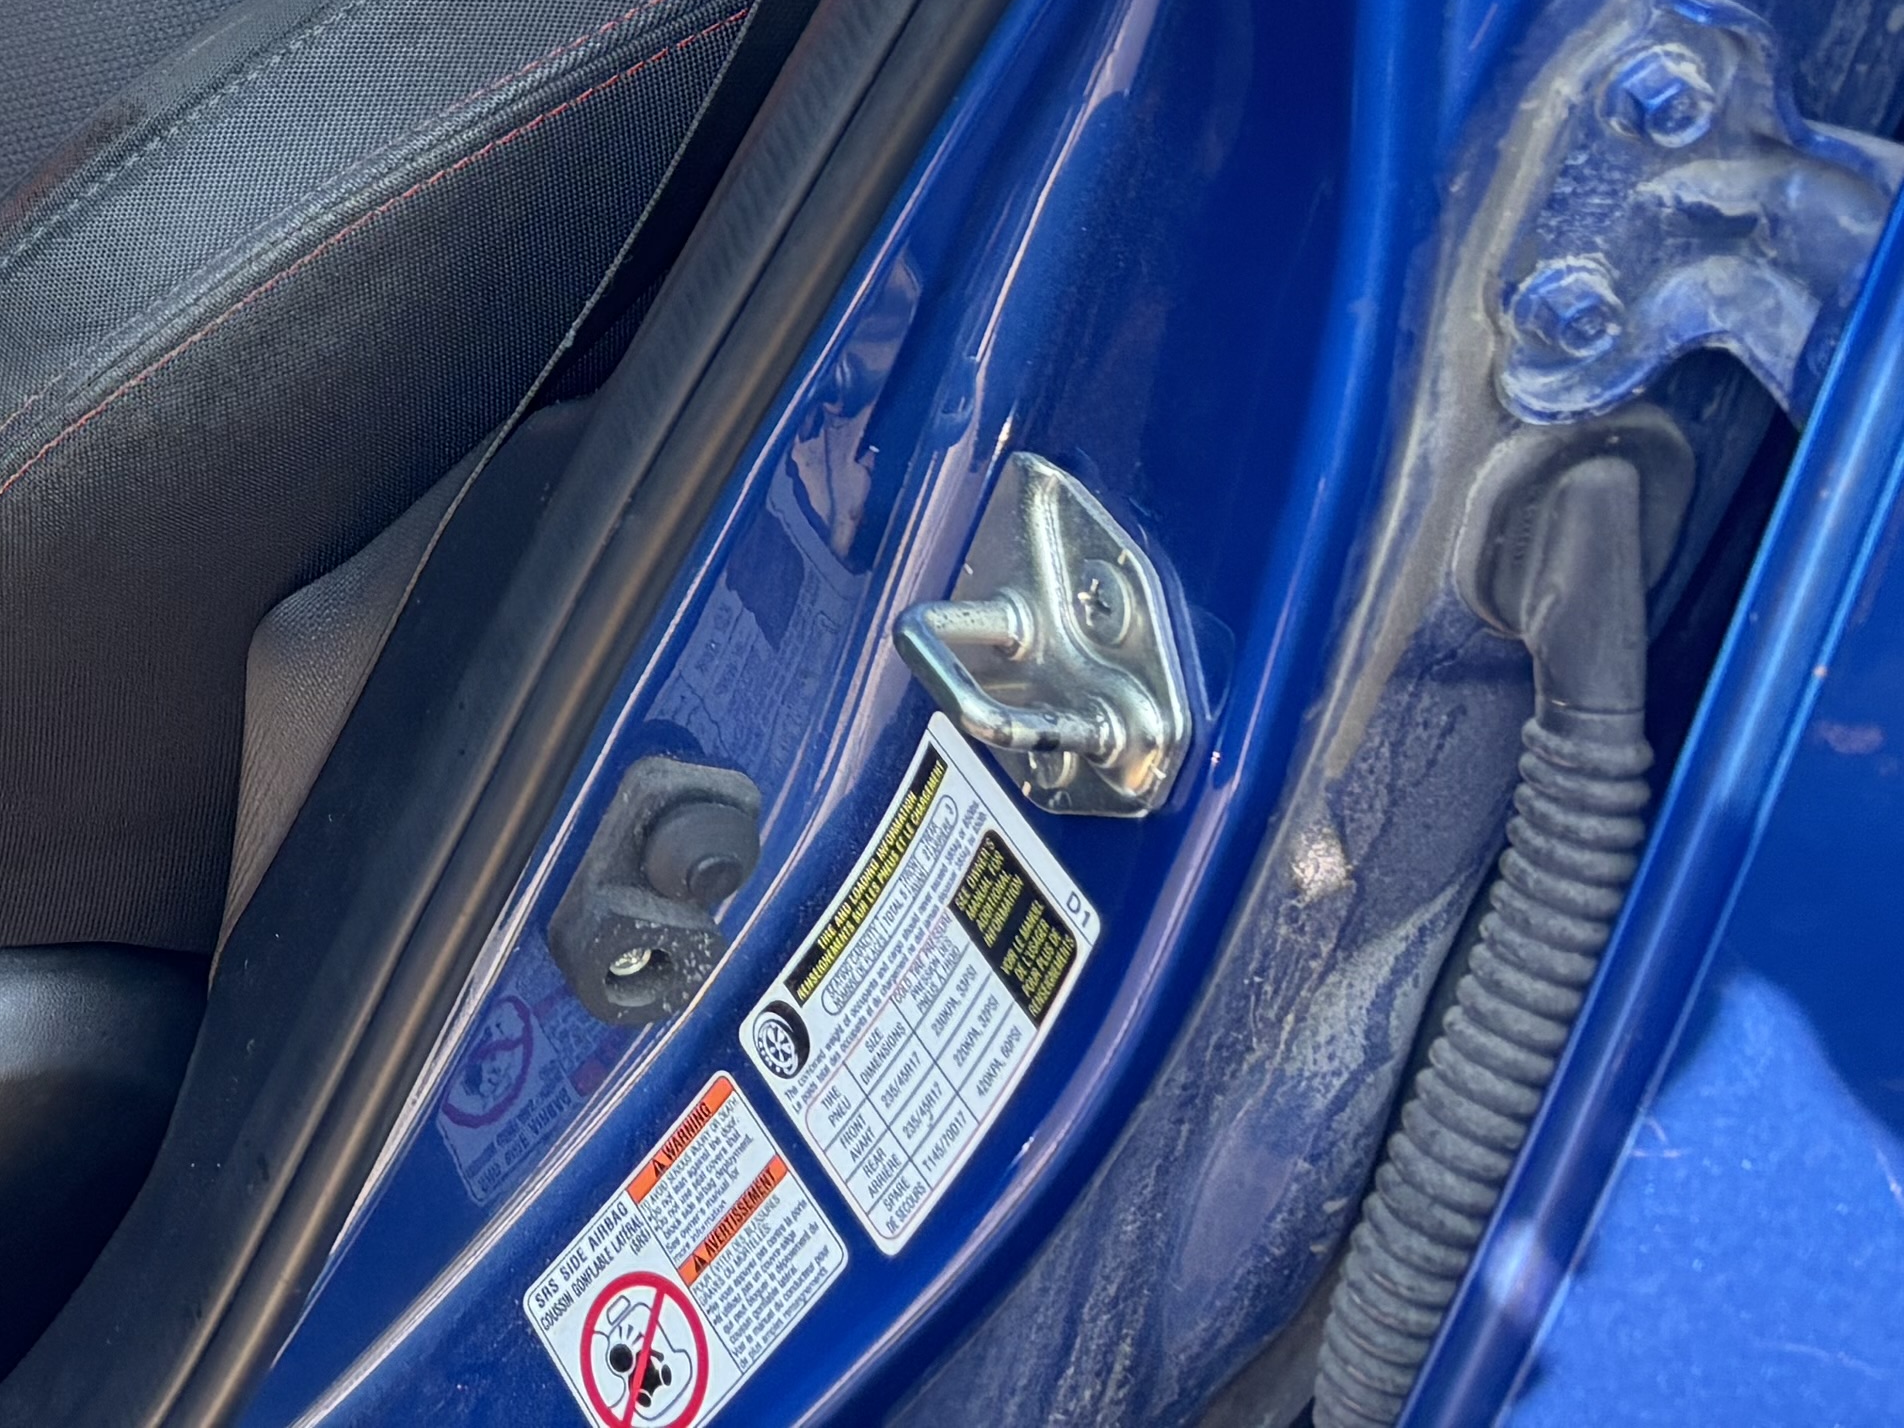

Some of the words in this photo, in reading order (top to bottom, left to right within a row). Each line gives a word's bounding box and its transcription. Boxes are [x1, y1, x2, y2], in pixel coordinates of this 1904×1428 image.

[796, 918, 855, 1001] RENSEIGNEMENTS
[851, 897, 869, 924] SUR
[864, 879, 880, 904] LES
[876, 847, 899, 885] PNEUS
[894, 834, 907, 854] ET
[902, 820, 915, 841] LE
[909, 759, 945, 828] CHARGEMENT
[816, 921, 837, 951] TIRE
[832, 899, 852, 929] AND
[847, 856, 880, 906] LOADING
[875, 789, 918, 862] INFORMATION
[953, 884, 971, 912] SEE
[964, 871, 993, 922] MANUAL
[987, 847, 1004, 877] FOR
[882, 895, 903, 927] TOTAL
[899, 887, 908, 900] 5
[974, 865, 1013, 933] ADDITIONAL
[982, 872, 1024, 949] INFORMATION
[1064, 889, 1092, 929] D1
[999, 945, 1019, 978] VOIR
[1011, 933, 1025, 955] LE
[1018, 895, 1045, 942] MANUEL
[1020, 965, 1042, 999] POUR
[1035, 939, 1056, 973] PLUS
[1047, 926, 1062, 948] DE
[954, 962, 977, 998] 33PSI
[1013, 960, 1027, 982] DE
[1027, 931, 1075, 1019] RENSEIGNEMENTS
[976, 992, 1000, 1029] 32PSI
[858, 1018, 907, 1086] DIMENSIONS
[863, 1025, 884, 1054] SIZE
[999, 1023, 1022, 1060] 60PSI
[820, 1083, 841, 1112] TIRE
[880, 1050, 922, 1110] 235/45R17
[661, 1099, 712, 1163] WARNING
[725, 1128, 741, 1149] that
[827, 1094, 852, 1128] PNEU
[838, 1112, 867, 1150] FRONT
[901, 1080, 944, 1140] 235/45R17
[848, 1124, 876, 1163] AVANT
[861, 1145, 887, 1179] REAR
[921, 1109, 968, 1174] T145/70D17
[659, 1190, 674, 1209] not
[708, 1134, 722, 1153] the
[882, 1174, 911, 1212] SPARE
[702, 1166, 778, 1259] AVERTISSEMENT
[885, 1215, 899, 1234] DE
[894, 1179, 927, 1223] SECOURS
[534, 1275, 559, 1310] SRS
[558, 1244, 588, 1283] SIDE
[586, 1198, 629, 1252] AIRBAG
[628, 1224, 652, 1257] (SRS)
[539, 1288, 574, 1333] COUSSIN
[570, 1244, 614, 1299] GONFLABLE
[608, 1209, 644, 1255] LATÉRAL
